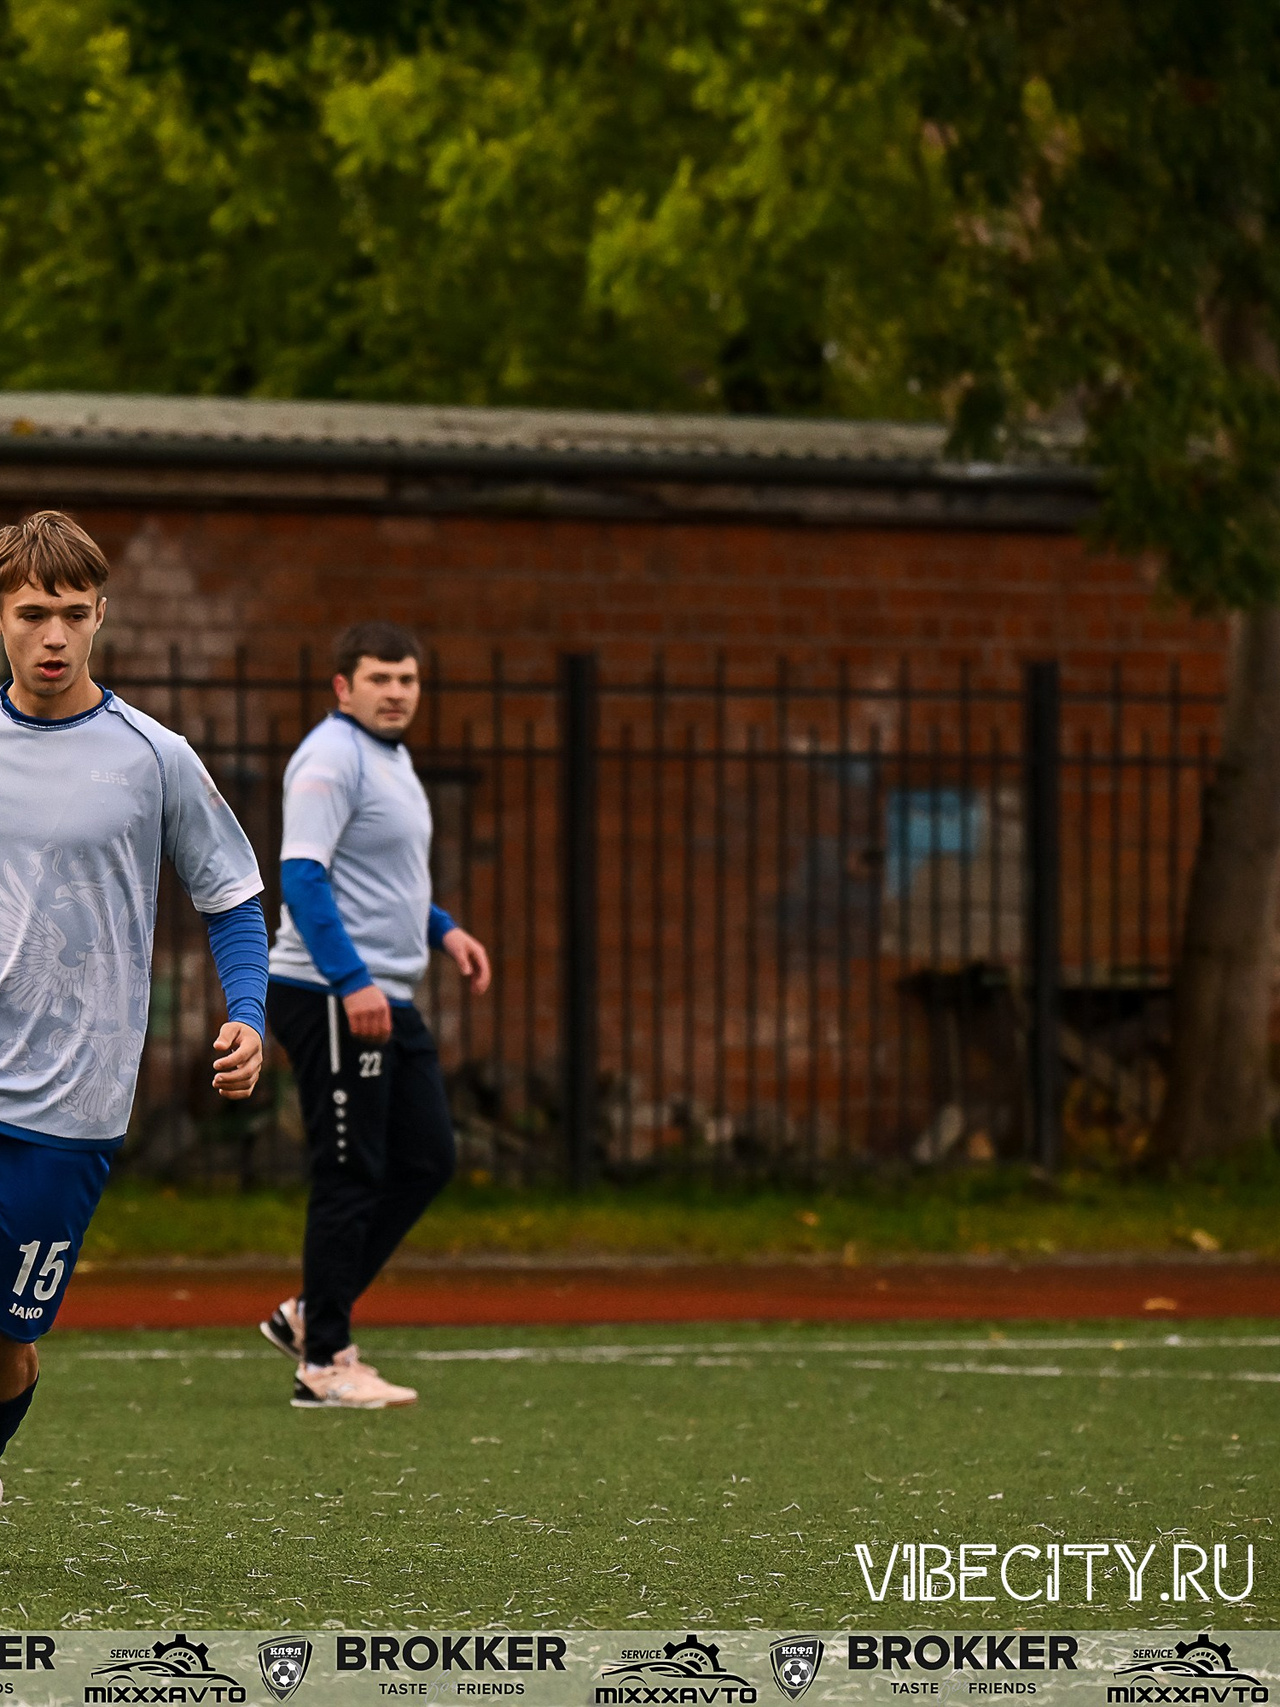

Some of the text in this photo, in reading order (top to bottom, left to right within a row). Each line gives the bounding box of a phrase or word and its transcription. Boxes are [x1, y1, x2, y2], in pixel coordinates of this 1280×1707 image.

[358, 1050, 383, 1078] 22
[12, 1240, 72, 1301] 15
[8, 1303, 44, 1320] JAKO
